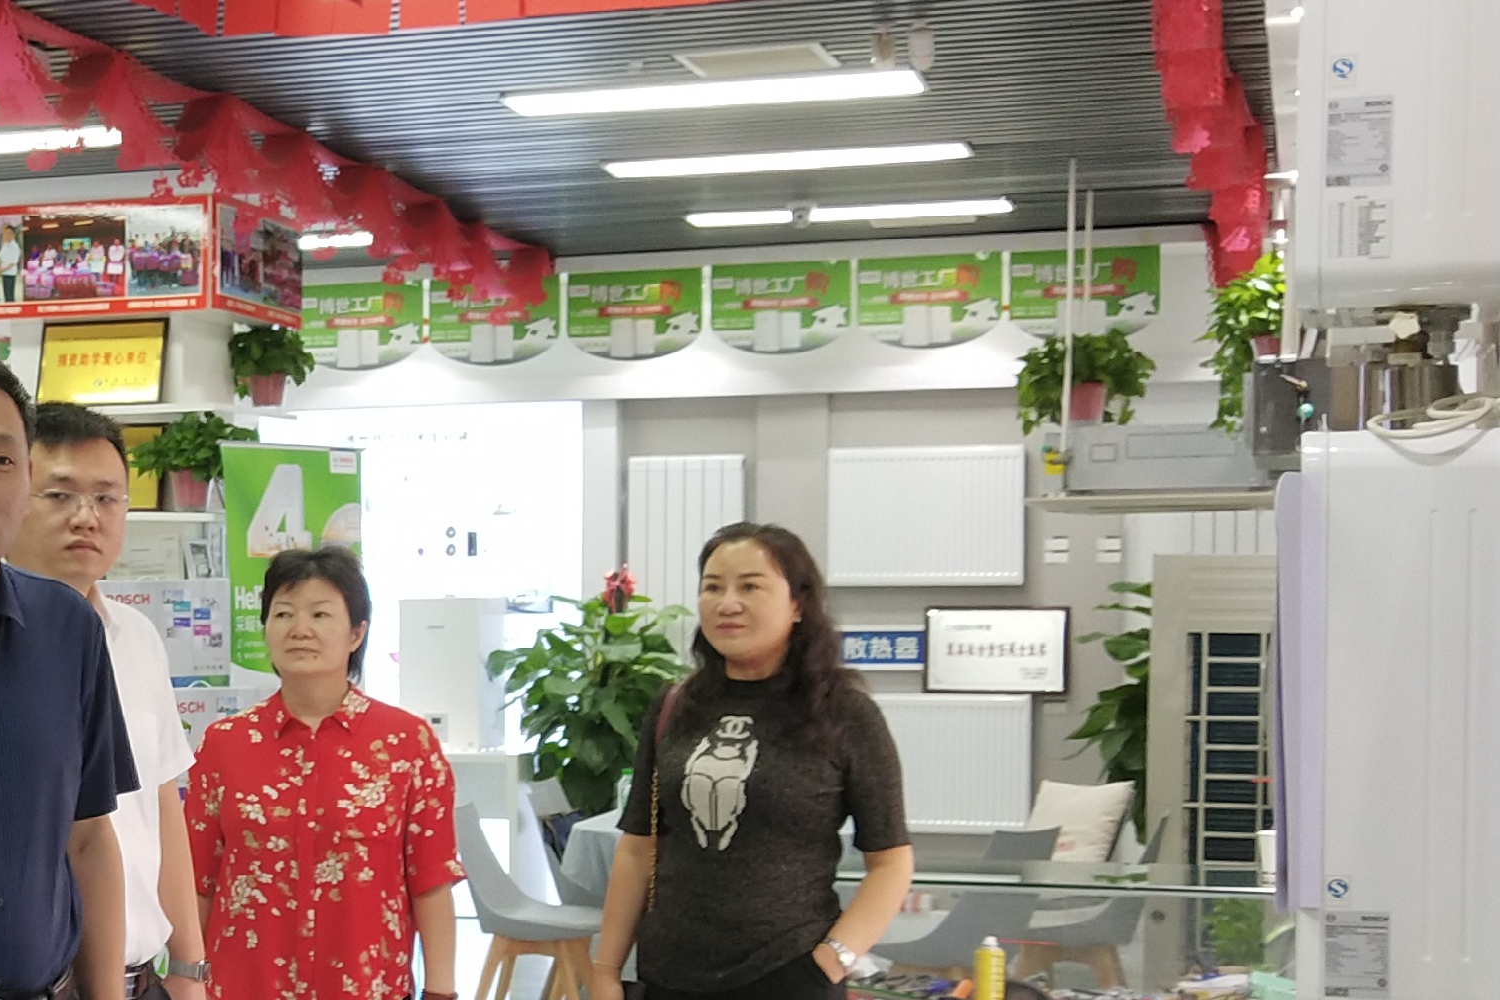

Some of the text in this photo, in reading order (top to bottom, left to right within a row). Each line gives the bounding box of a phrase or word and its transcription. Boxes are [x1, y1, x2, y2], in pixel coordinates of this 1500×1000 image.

[843, 636, 920, 660] 散热器
[177, 701, 205, 713] SCH
